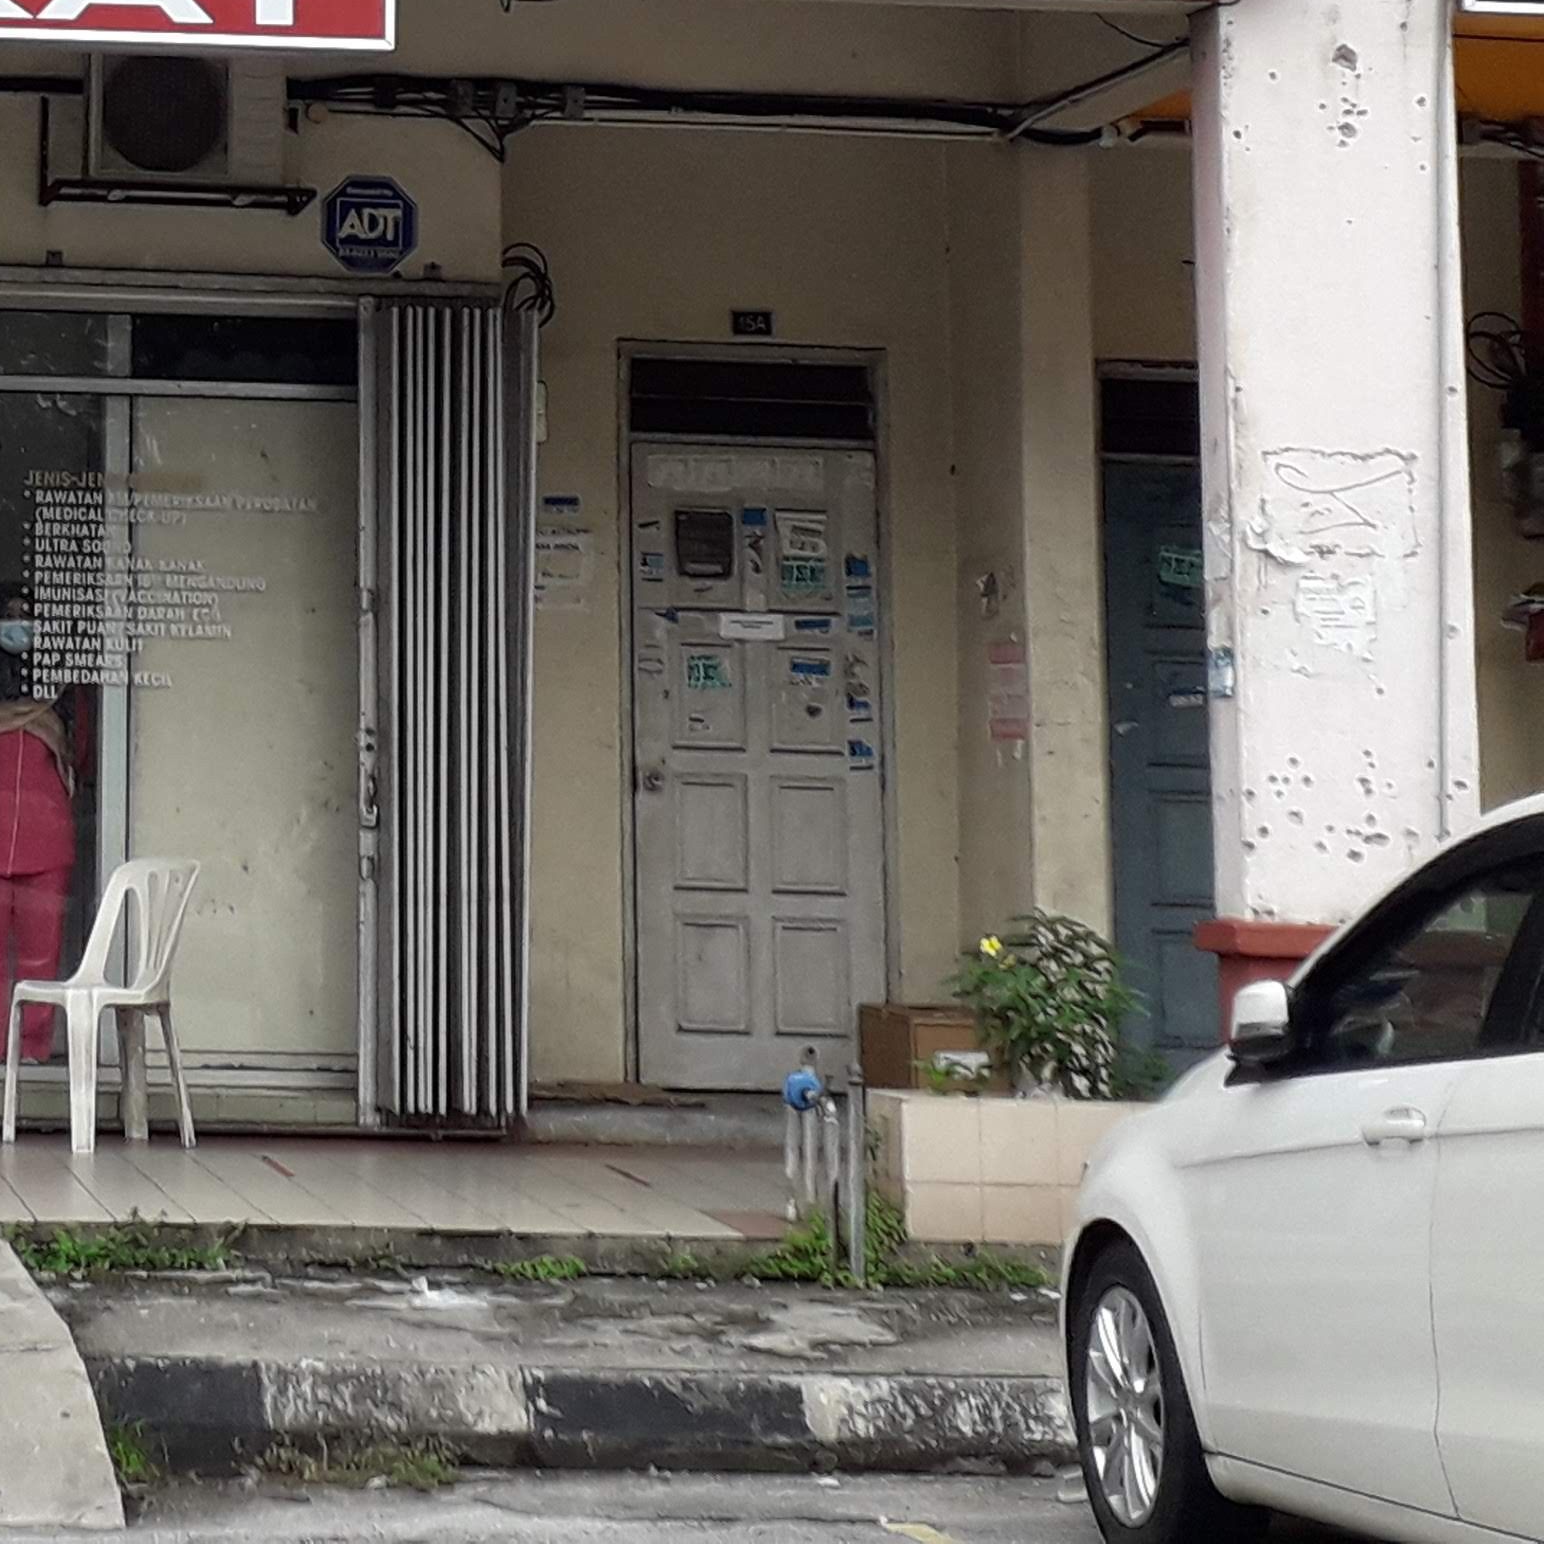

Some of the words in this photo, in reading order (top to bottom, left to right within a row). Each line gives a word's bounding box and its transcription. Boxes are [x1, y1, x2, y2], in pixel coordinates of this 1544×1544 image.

[337, 207, 403, 241] ADT
[35, 489, 103, 505] RAWATAN
[34, 538, 78, 553] ULTRA
[34, 554, 103, 569] RAWATAN
[33, 620, 73, 635] SAKIT
[33, 637, 101, 652] RAWATAN
[33, 652, 61, 666] PAP
[33, 684, 58, 700] DLL
